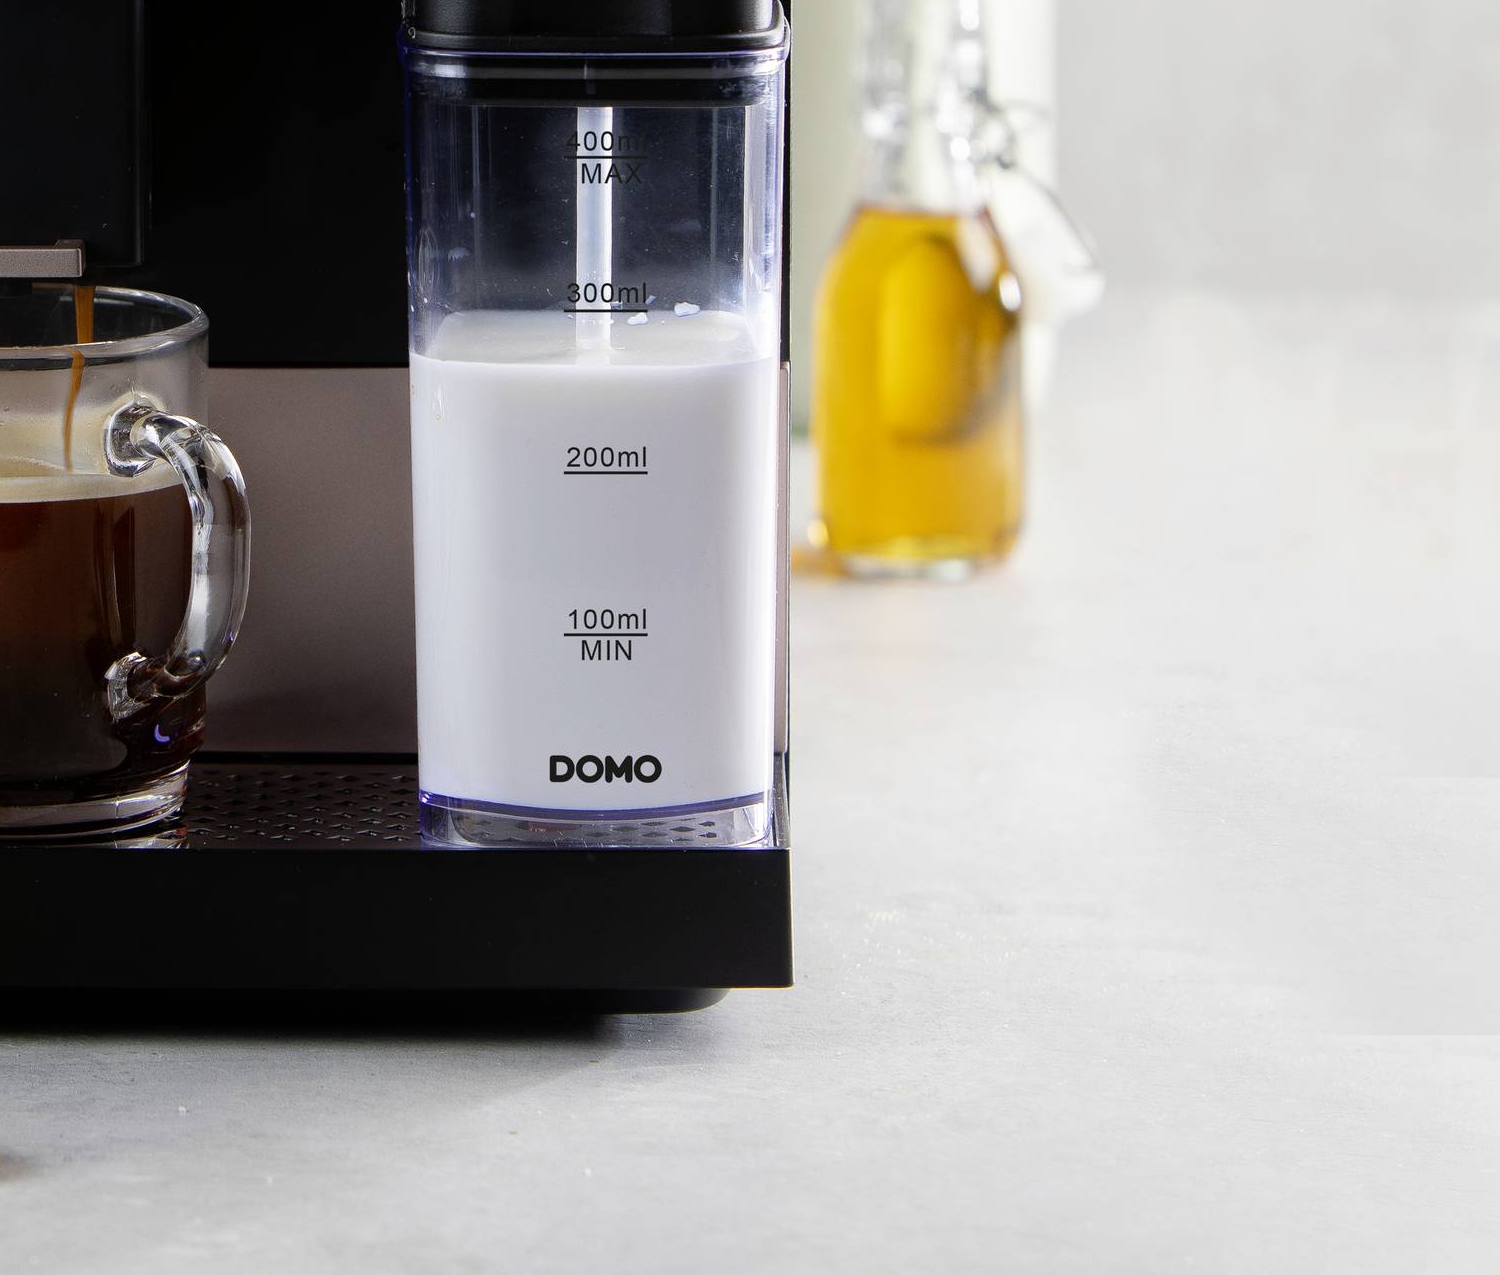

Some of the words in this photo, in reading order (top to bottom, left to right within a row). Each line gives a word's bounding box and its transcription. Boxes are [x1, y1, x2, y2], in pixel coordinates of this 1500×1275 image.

[581, 163, 642, 183] MAX
[567, 283, 647, 303] 300ml
[567, 446, 646, 467] 200ml
[569, 609, 646, 629] 100ml
[582, 640, 631, 660] MIN
[550, 755, 662, 783] DOMO
